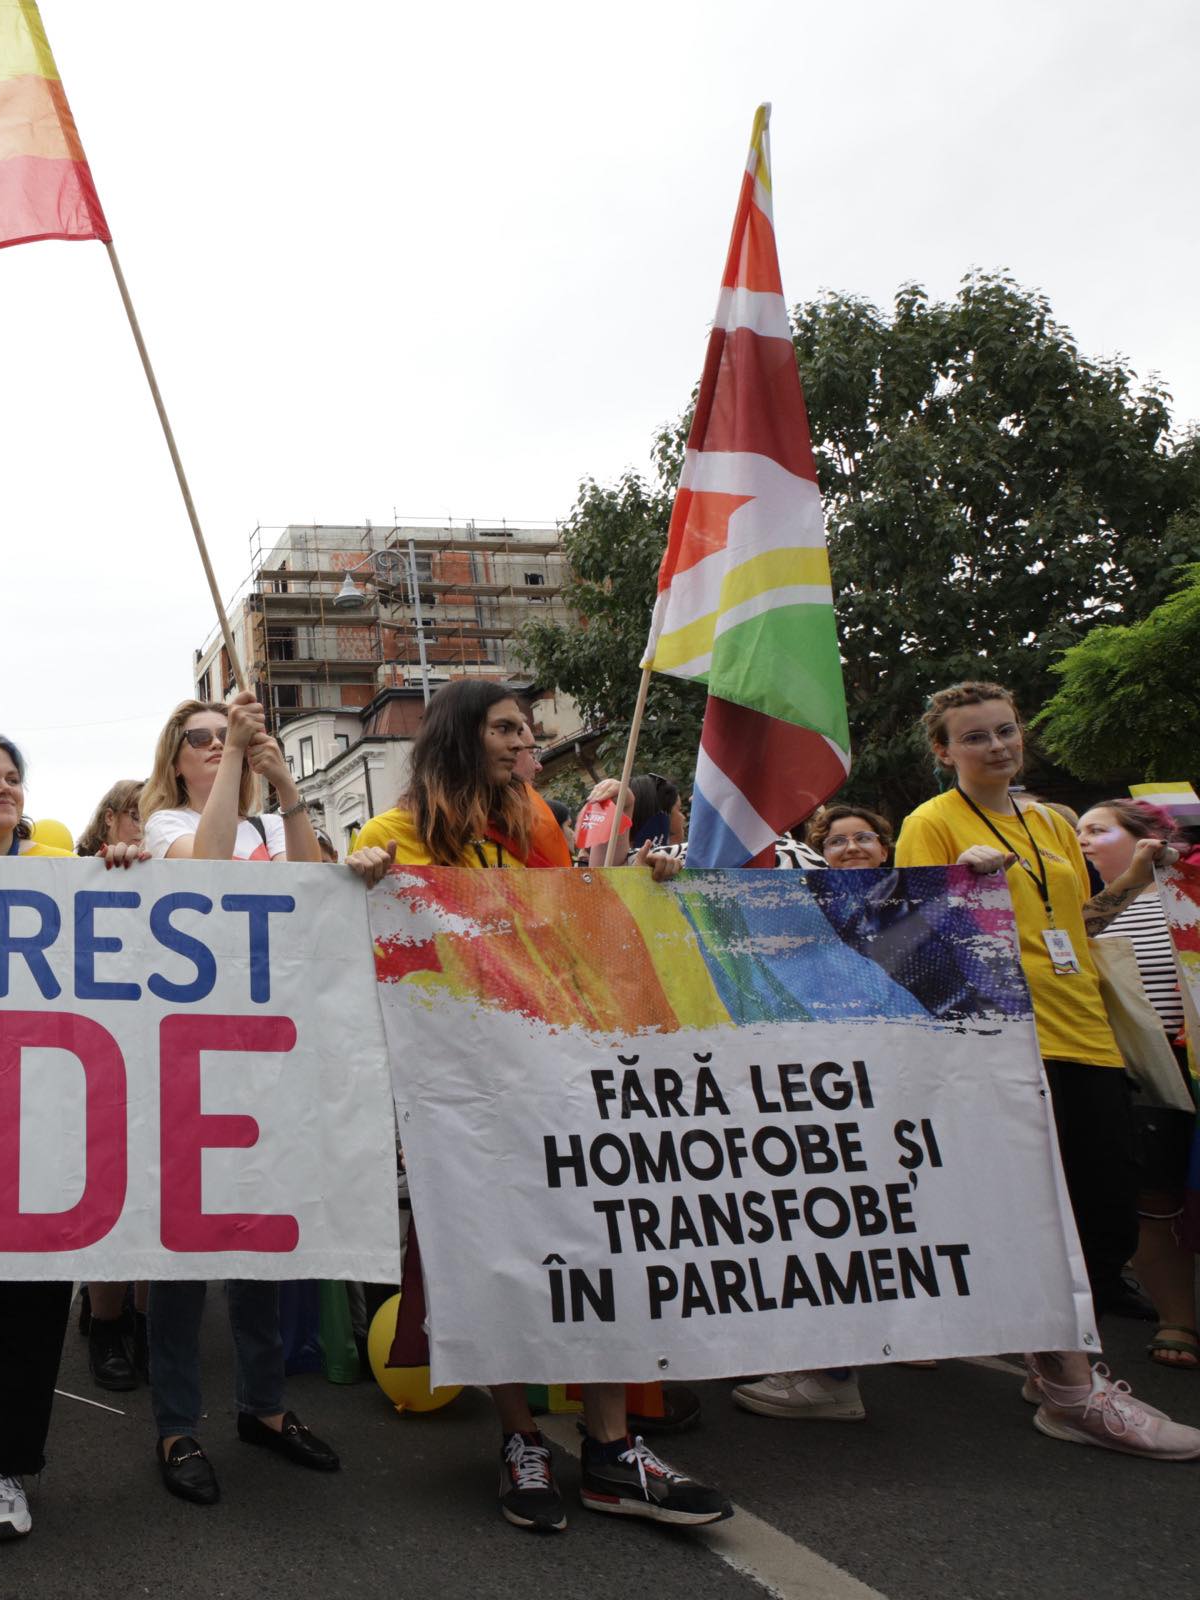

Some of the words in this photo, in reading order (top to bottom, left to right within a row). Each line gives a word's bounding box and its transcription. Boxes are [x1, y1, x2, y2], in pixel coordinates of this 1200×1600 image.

[590, 1053, 730, 1120] FĂRĂ
[749, 1060, 874, 1113] LEGI
[543, 1122, 867, 1188] HOMOFOBE
[893, 1118, 943, 1192] ȘI
[593, 1183, 917, 1254] TRANSFOBE
[542, 1253, 616, 1323] ÎN
[646, 1244, 971, 1320] PARLAMENT
